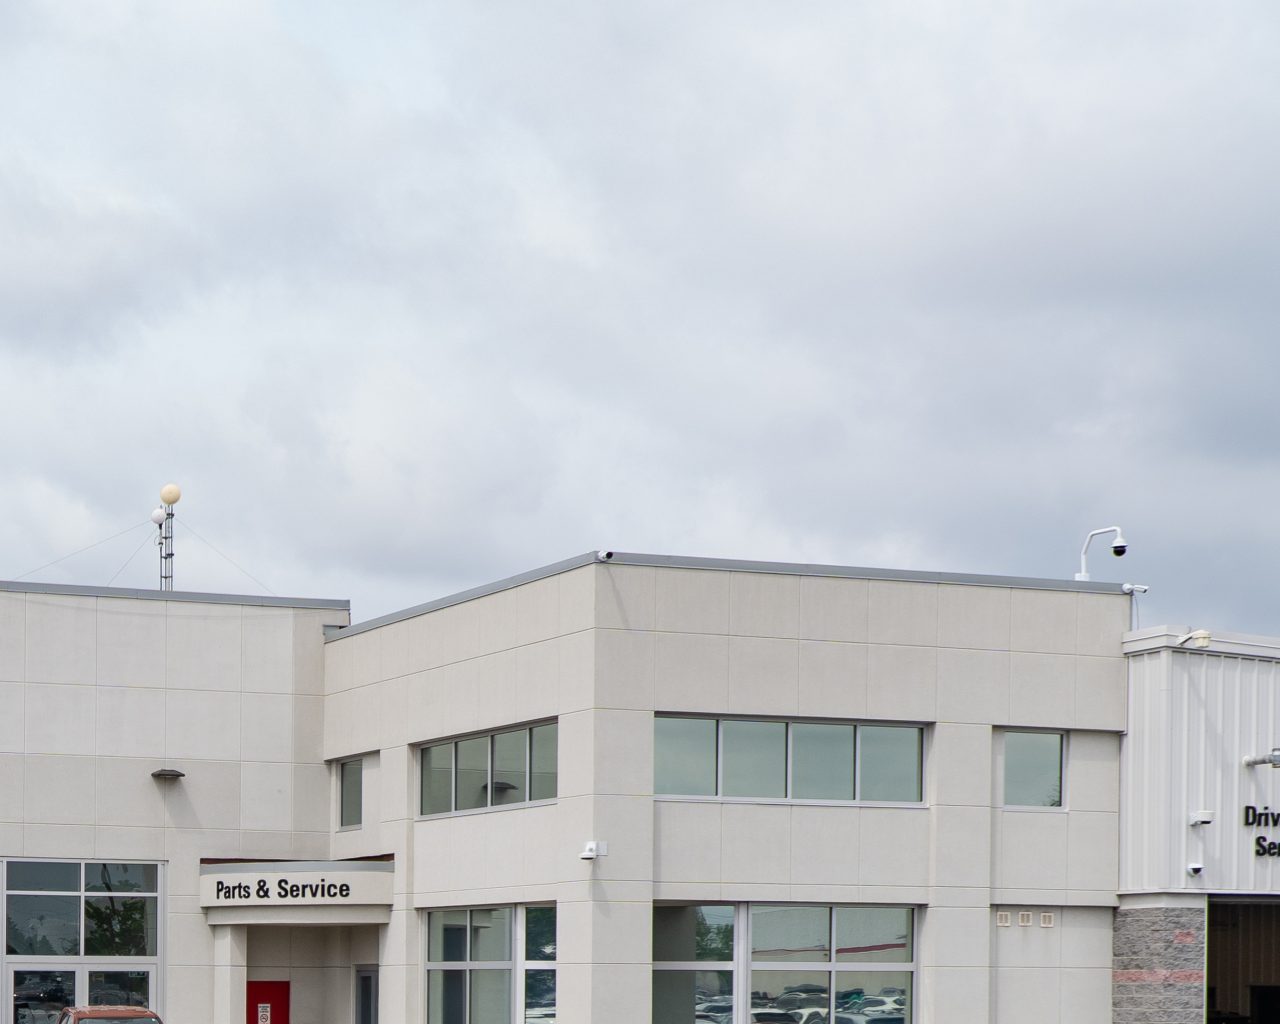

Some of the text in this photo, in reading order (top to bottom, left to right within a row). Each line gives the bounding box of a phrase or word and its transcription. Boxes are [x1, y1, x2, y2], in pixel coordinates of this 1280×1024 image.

[1243, 805, 1280, 827] Driv
[216, 878, 351, 900] Parts & Service
